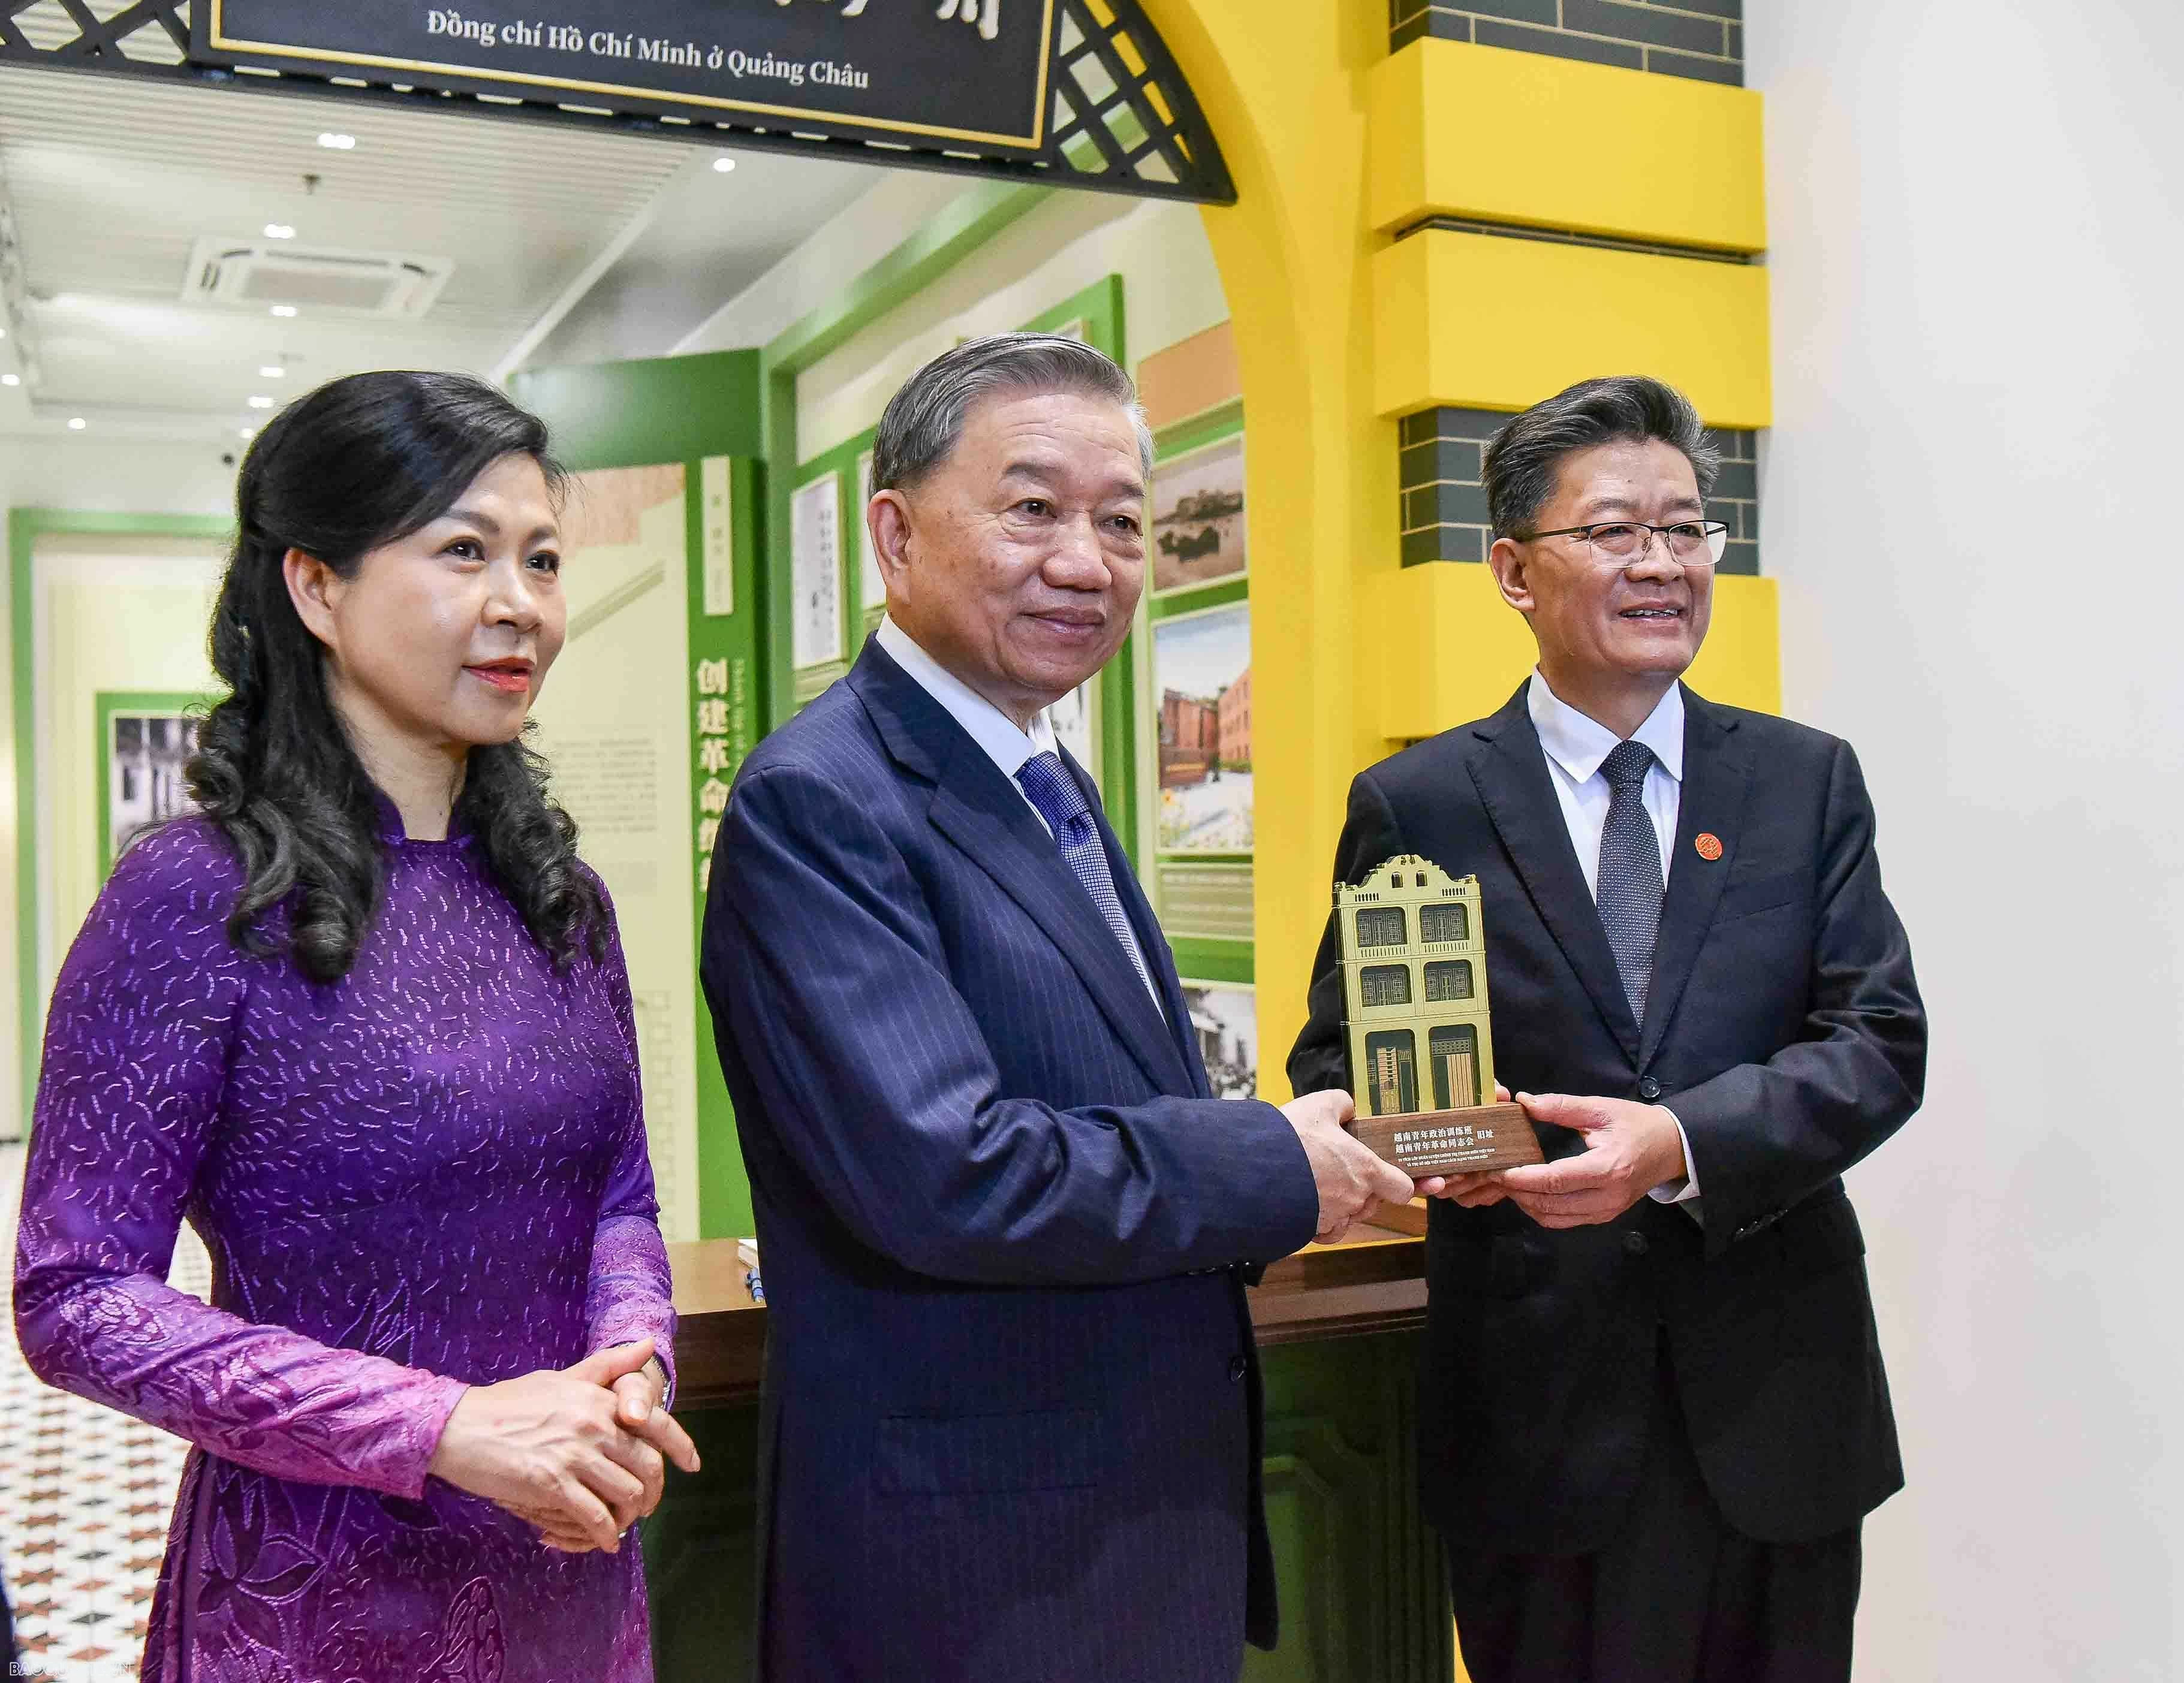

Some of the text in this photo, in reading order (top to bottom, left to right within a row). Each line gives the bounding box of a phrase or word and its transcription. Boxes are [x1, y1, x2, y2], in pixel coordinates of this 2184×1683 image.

[427, 9, 869, 89] Đồng chí Hồ Chí Minh ở Quảng Châu
[697, 656, 730, 892] 创建革命
[1394, 1125, 1495, 1142] 越南青年政治训练班 旧址
[1396, 1136, 1475, 1154] 越南青年革命同志会
